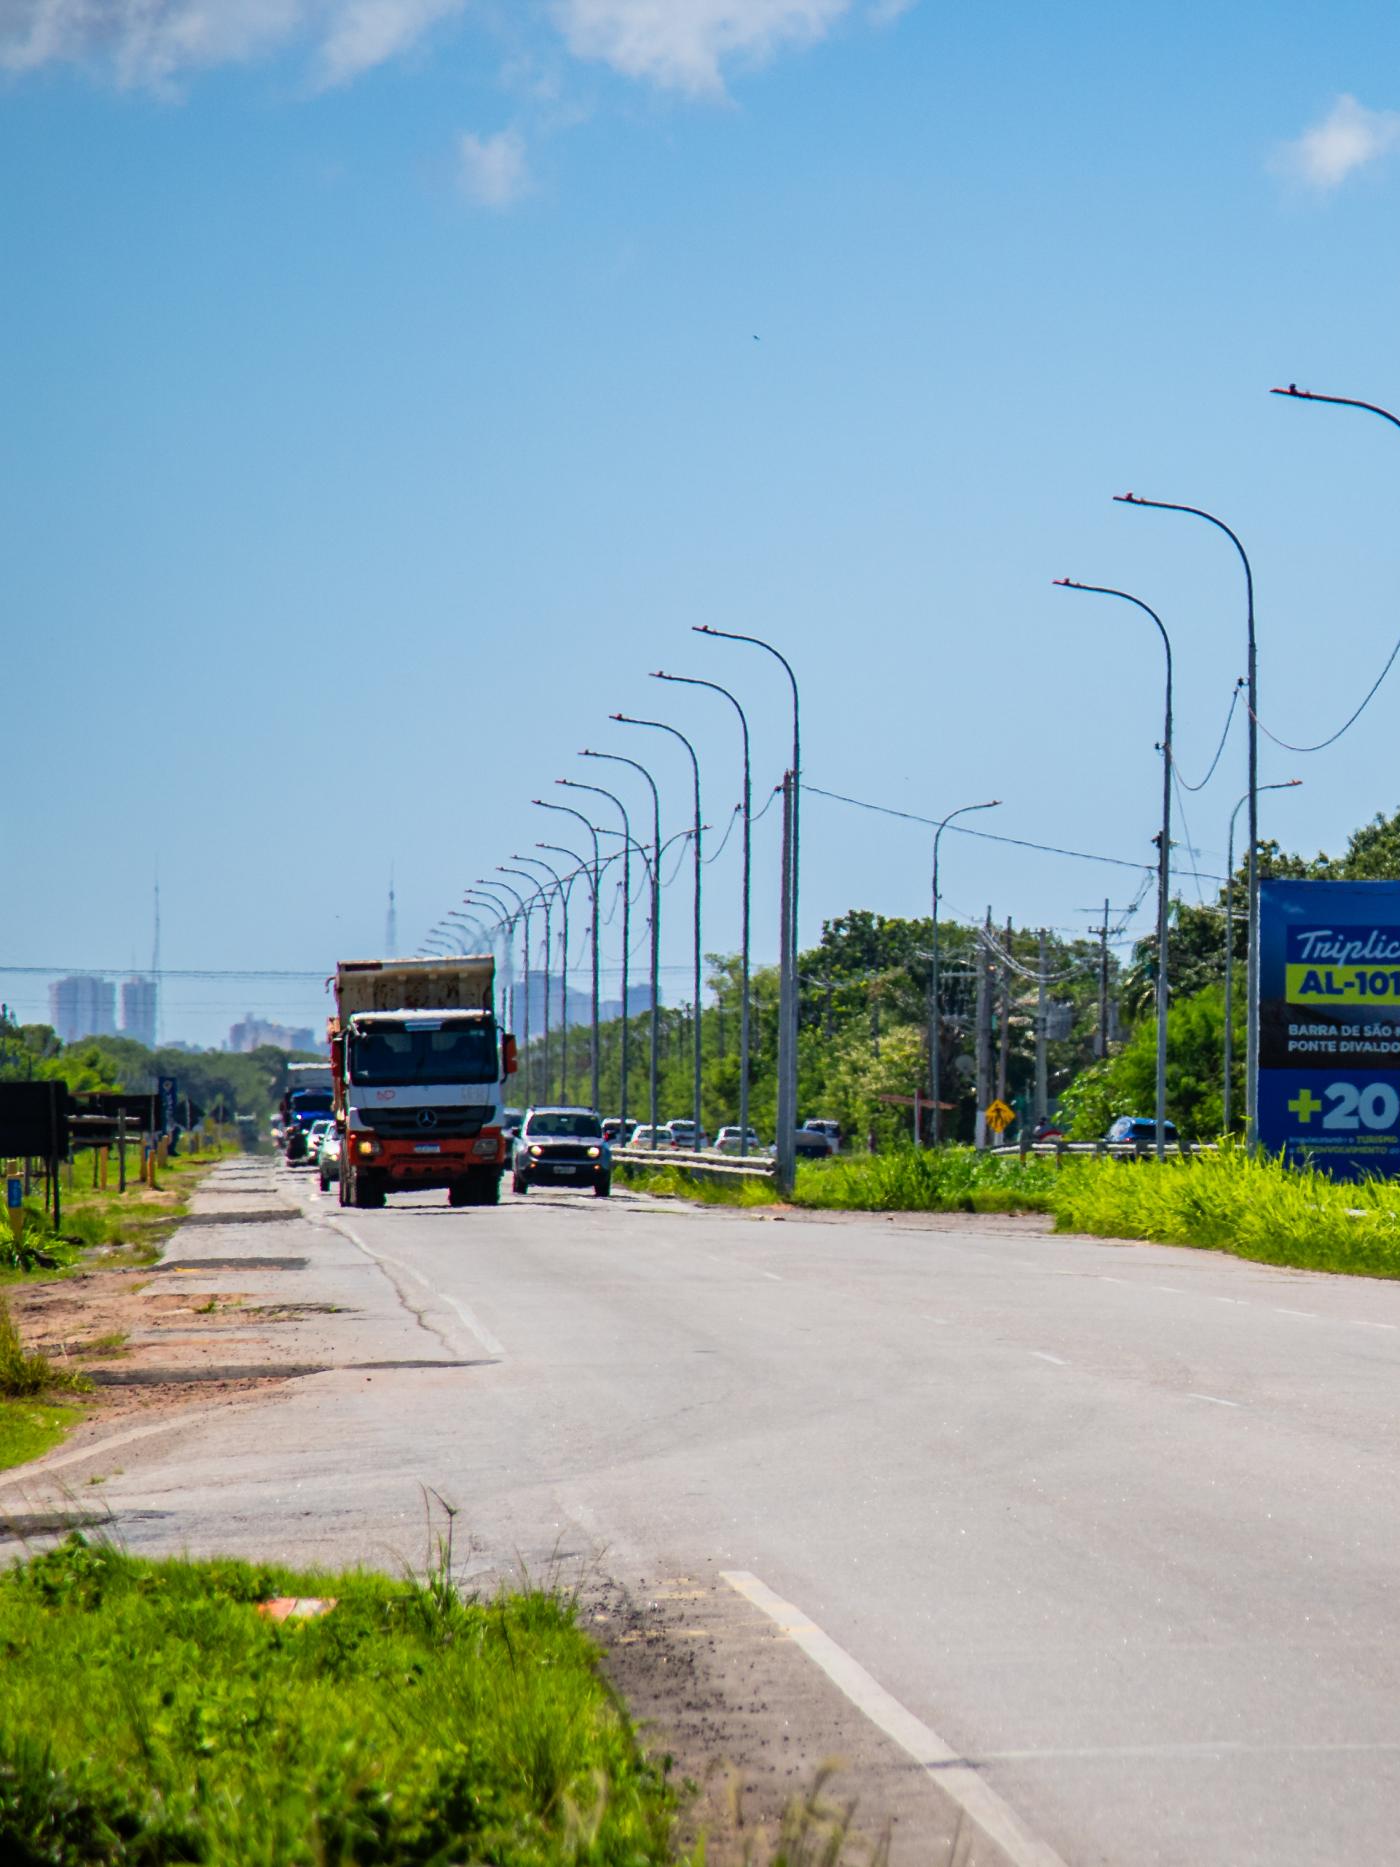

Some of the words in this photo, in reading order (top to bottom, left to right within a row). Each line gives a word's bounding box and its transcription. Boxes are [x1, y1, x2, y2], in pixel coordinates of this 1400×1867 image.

[1288, 1024, 1337, 1037] BARRA
[1341, 1024, 1361, 1037] DE
[1363, 1022, 1393, 1037] SÃO
[1288, 1040, 1337, 1052] PONTE
